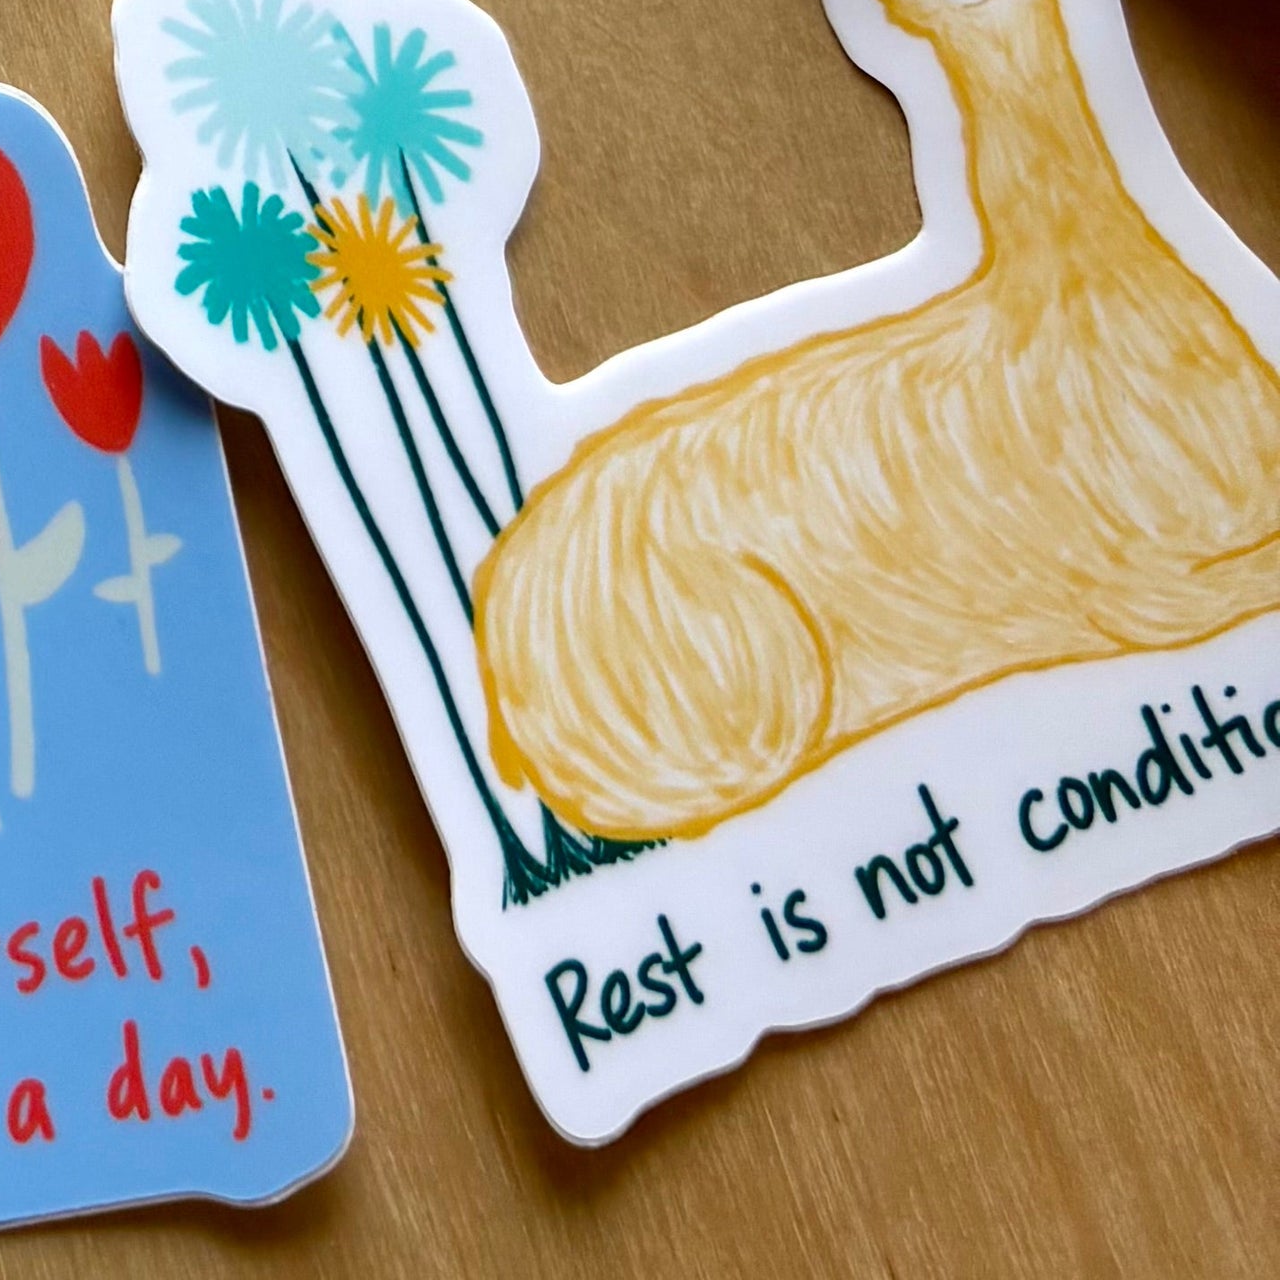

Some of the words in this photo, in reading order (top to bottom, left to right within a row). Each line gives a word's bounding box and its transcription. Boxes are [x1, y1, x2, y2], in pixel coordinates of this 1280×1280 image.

[544, 913, 705, 1073] Rest
[750, 881, 829, 962] is
[854, 783, 976, 920] not
[6, 1079, 57, 1144] a
[106, 1019, 277, 1142] day.
